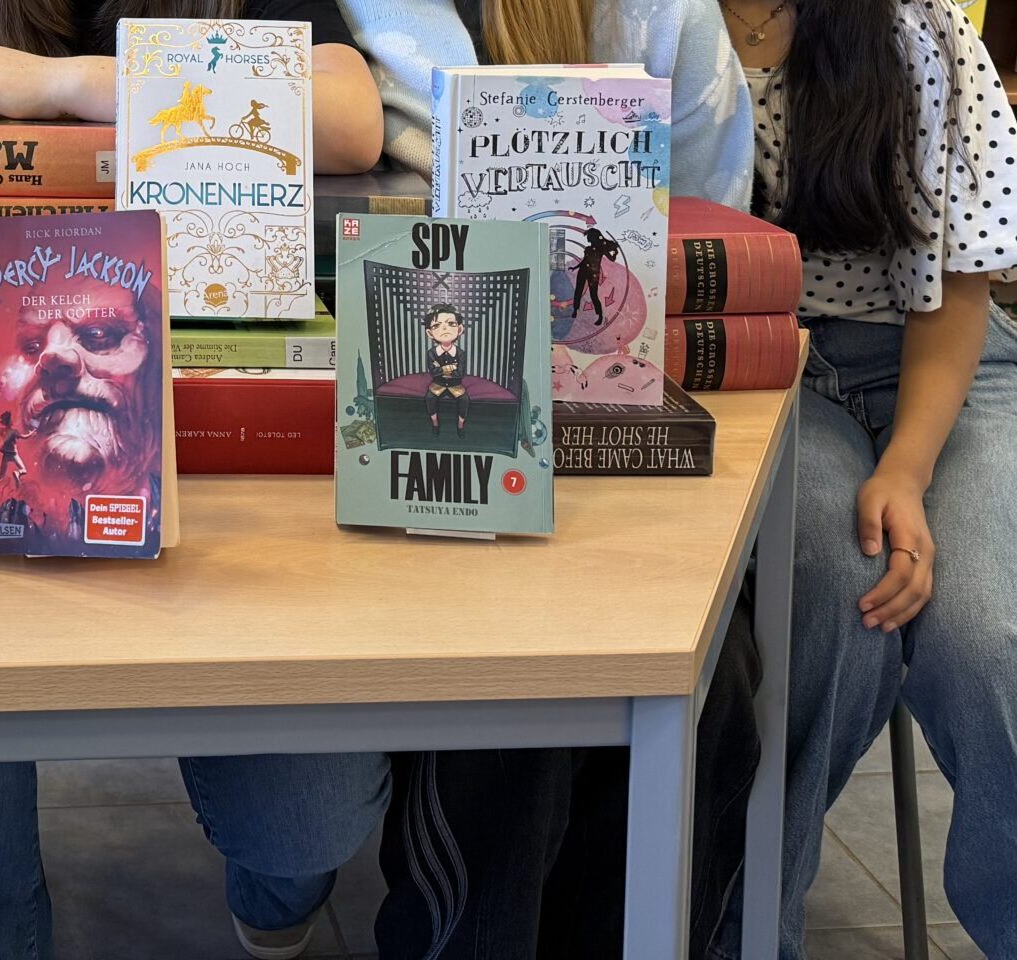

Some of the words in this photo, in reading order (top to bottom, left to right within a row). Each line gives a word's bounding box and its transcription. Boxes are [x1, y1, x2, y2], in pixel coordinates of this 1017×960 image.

[167, 54, 204, 64] ROYAL
[226, 54, 270, 64] HORSES
[480, 91, 536, 105] Stefanie
[470, 128, 652, 158] PLÖTZLICH
[100, 160, 110, 174] JM
[184, 162, 212, 171] JANA
[218, 162, 250, 172] HOCH
[8, 174, 42, 186] Hans
[460, 160, 660, 199] VERTAUSCHT
[130, 181, 304, 208] KRONENHERZ
[26, 229, 50, 238] RICK
[54, 227, 102, 238] RIORDAN
[411, 222, 469, 271] SPY
[706, 241, 716, 259] DIE
[65, 246, 152, 301] JACKSON
[694, 242, 706, 311] DEUTSCHEN
[707, 262, 718, 312] GROSSEN
[22, 296, 46, 306] DER
[51, 294, 91, 305] KELCH
[38, 310, 62, 320] DER
[66, 307, 116, 318] GÖTTER
[706, 322, 716, 340] DIE
[184, 344, 194, 352] der
[196, 344, 222, 352] Stimme
[224, 344, 237, 352] Die
[292, 345, 302, 362] DU
[196, 354, 222, 362] Andrea
[562, 426, 594, 446] HER
[598, 426, 644, 446] SHOT
[648, 426, 669, 446] HE
[599, 448, 644, 468] CAME
[647, 448, 695, 468] WHAT
[390, 450, 494, 505] FAMILY
[510, 478, 516, 488] 7
[90, 504, 108, 512] Dein
[109, 504, 140, 514] SPIEGEL
[406, 504, 450, 516] TATSUYA
[452, 506, 478, 517] ENDO
[92, 516, 138, 526] Bestseller-
[102, 526, 127, 536] Autor
